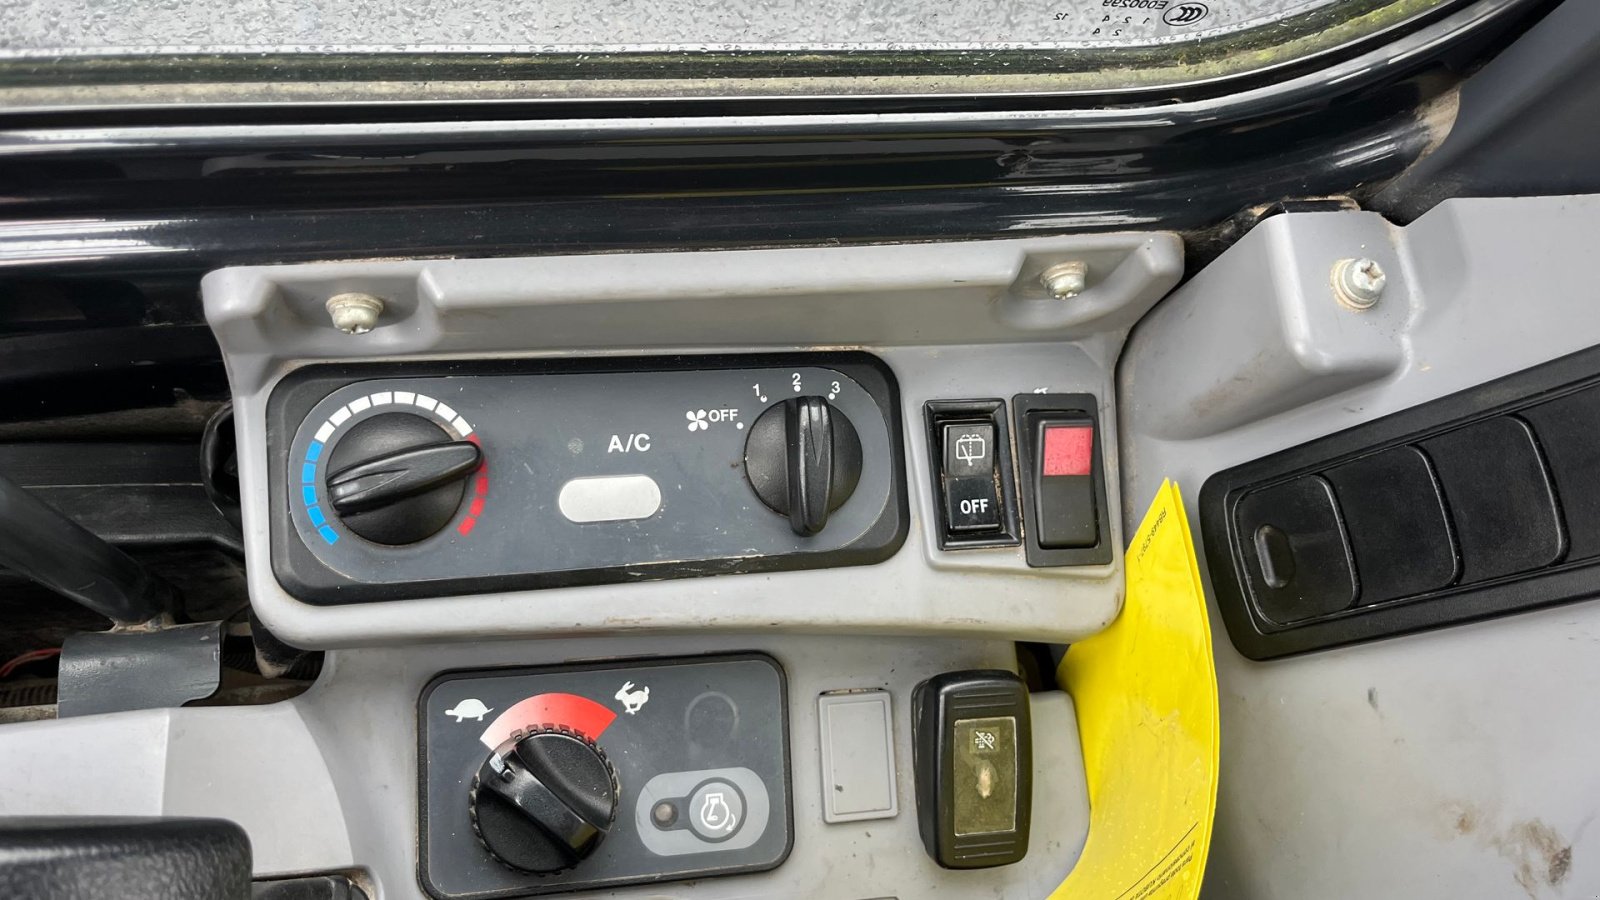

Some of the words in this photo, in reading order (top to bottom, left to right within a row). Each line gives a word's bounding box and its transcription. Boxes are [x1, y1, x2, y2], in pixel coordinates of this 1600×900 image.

[791, 372, 802, 386] 2
[752, 383, 760, 397] 1
[831, 381, 841, 394] 3
[708, 408, 739, 423] OFF
[607, 433, 651, 453] A/C
[960, 498, 989, 515] OFF
